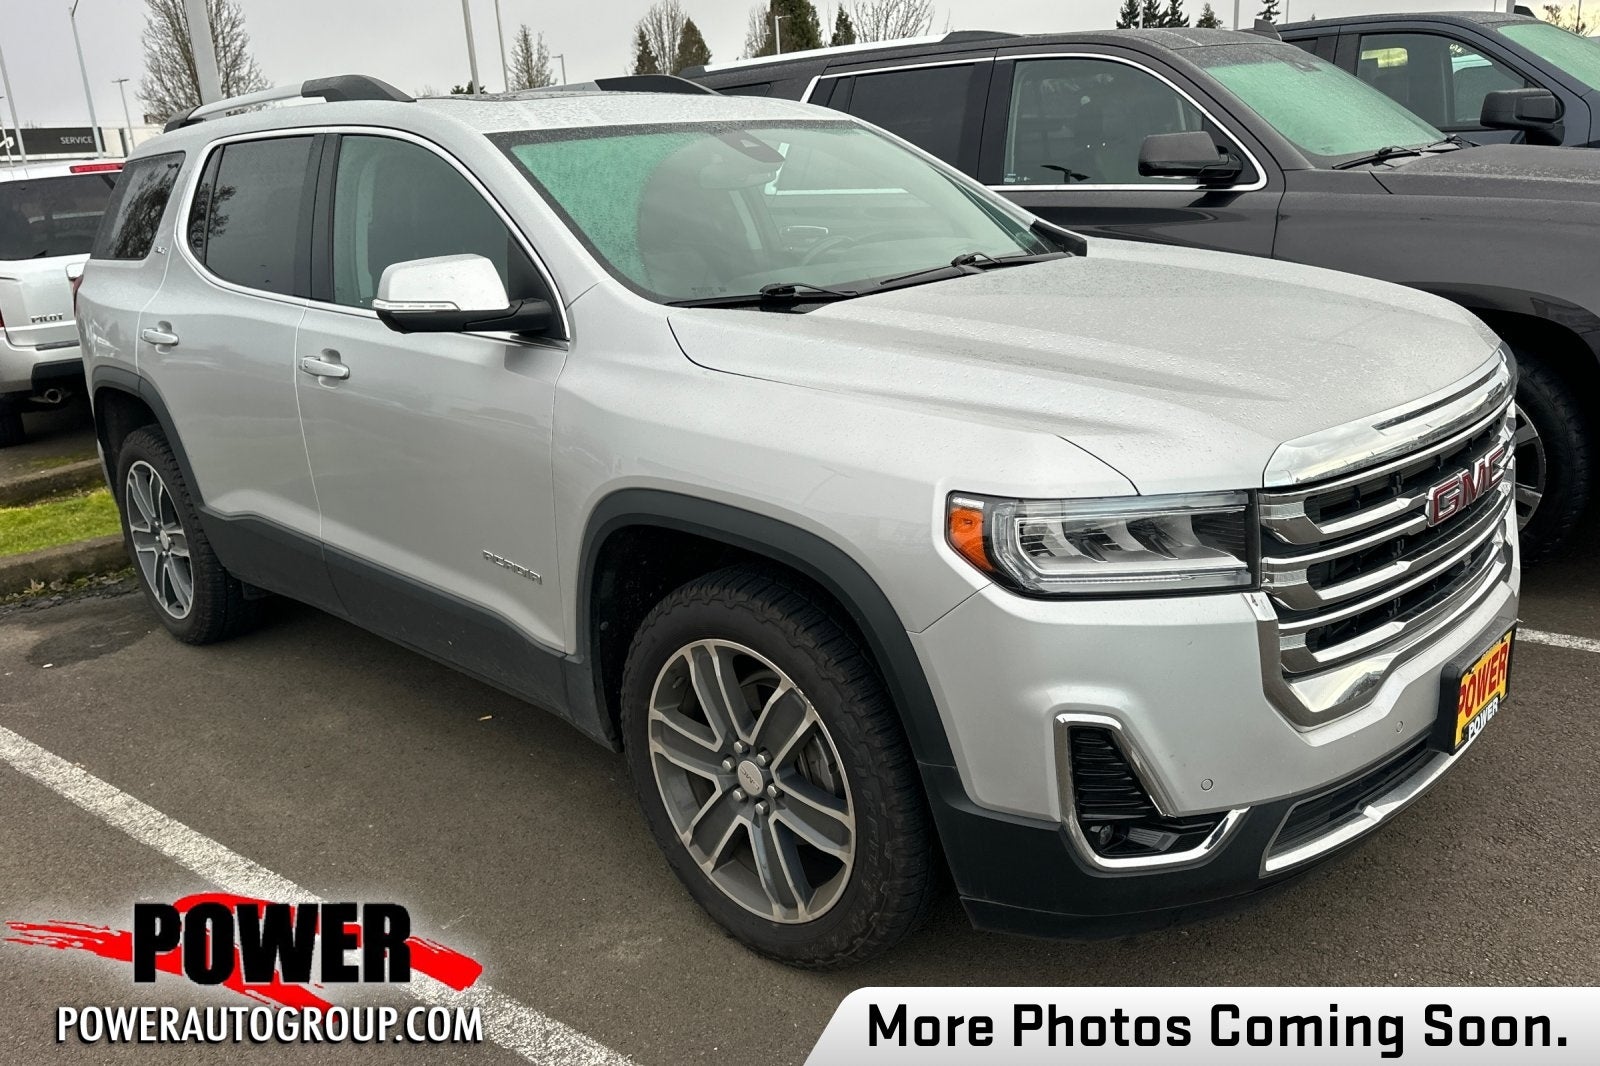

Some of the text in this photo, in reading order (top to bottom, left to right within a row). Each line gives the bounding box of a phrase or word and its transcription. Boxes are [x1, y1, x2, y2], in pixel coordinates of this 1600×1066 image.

[60, 136, 93, 144] SERVICE
[30, 312, 64, 323] PILOT
[1426, 443, 1505, 527] GMC
[482, 549, 543, 585] ACADIA
[1458, 641, 1508, 718] POWER
[1467, 696, 1499, 740] POWER
